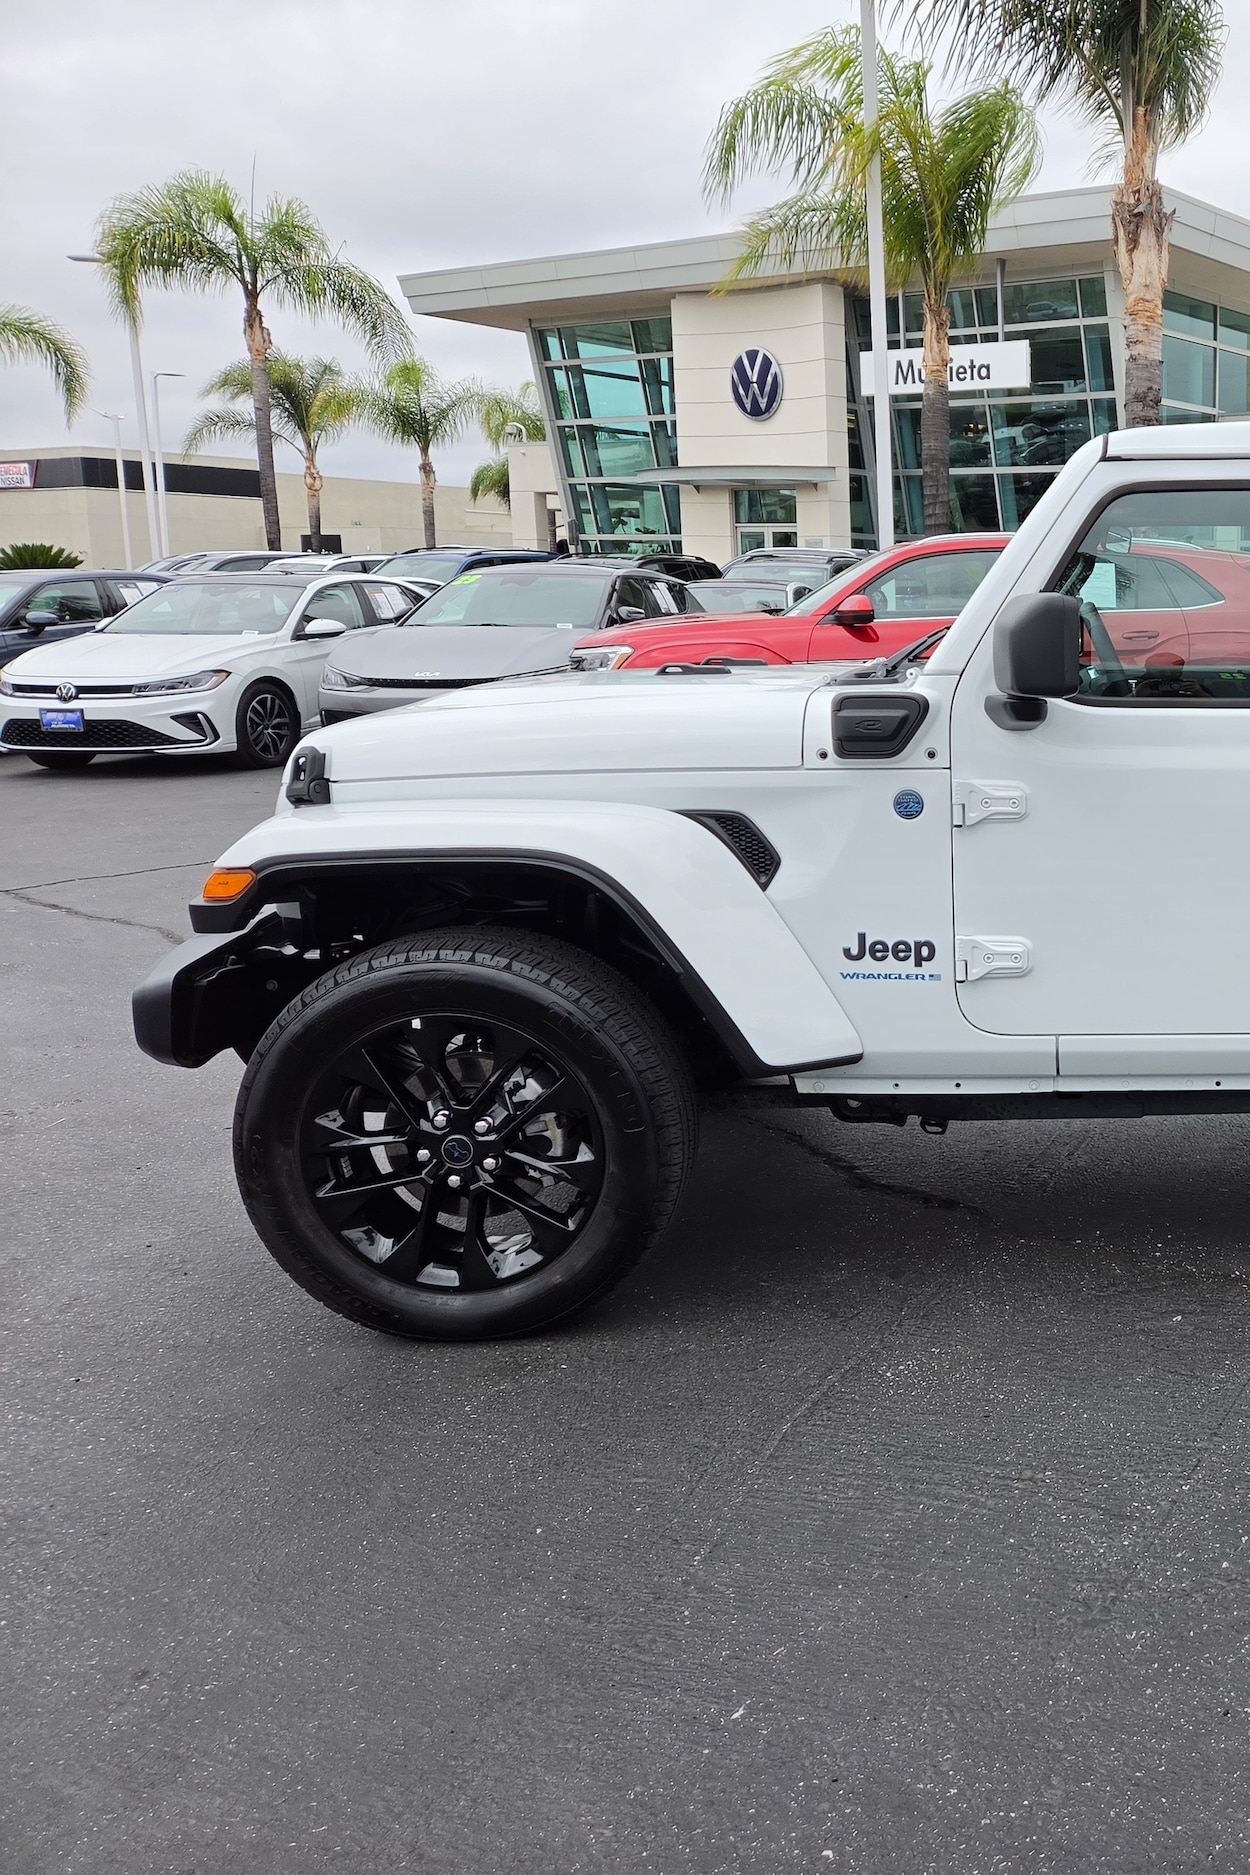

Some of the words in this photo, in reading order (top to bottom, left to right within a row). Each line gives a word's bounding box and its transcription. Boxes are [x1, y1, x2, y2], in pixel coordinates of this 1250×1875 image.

[894, 358, 991, 386] Muieta
[842, 931, 936, 967] Jeep
[840, 972, 927, 981] WRANGLER
